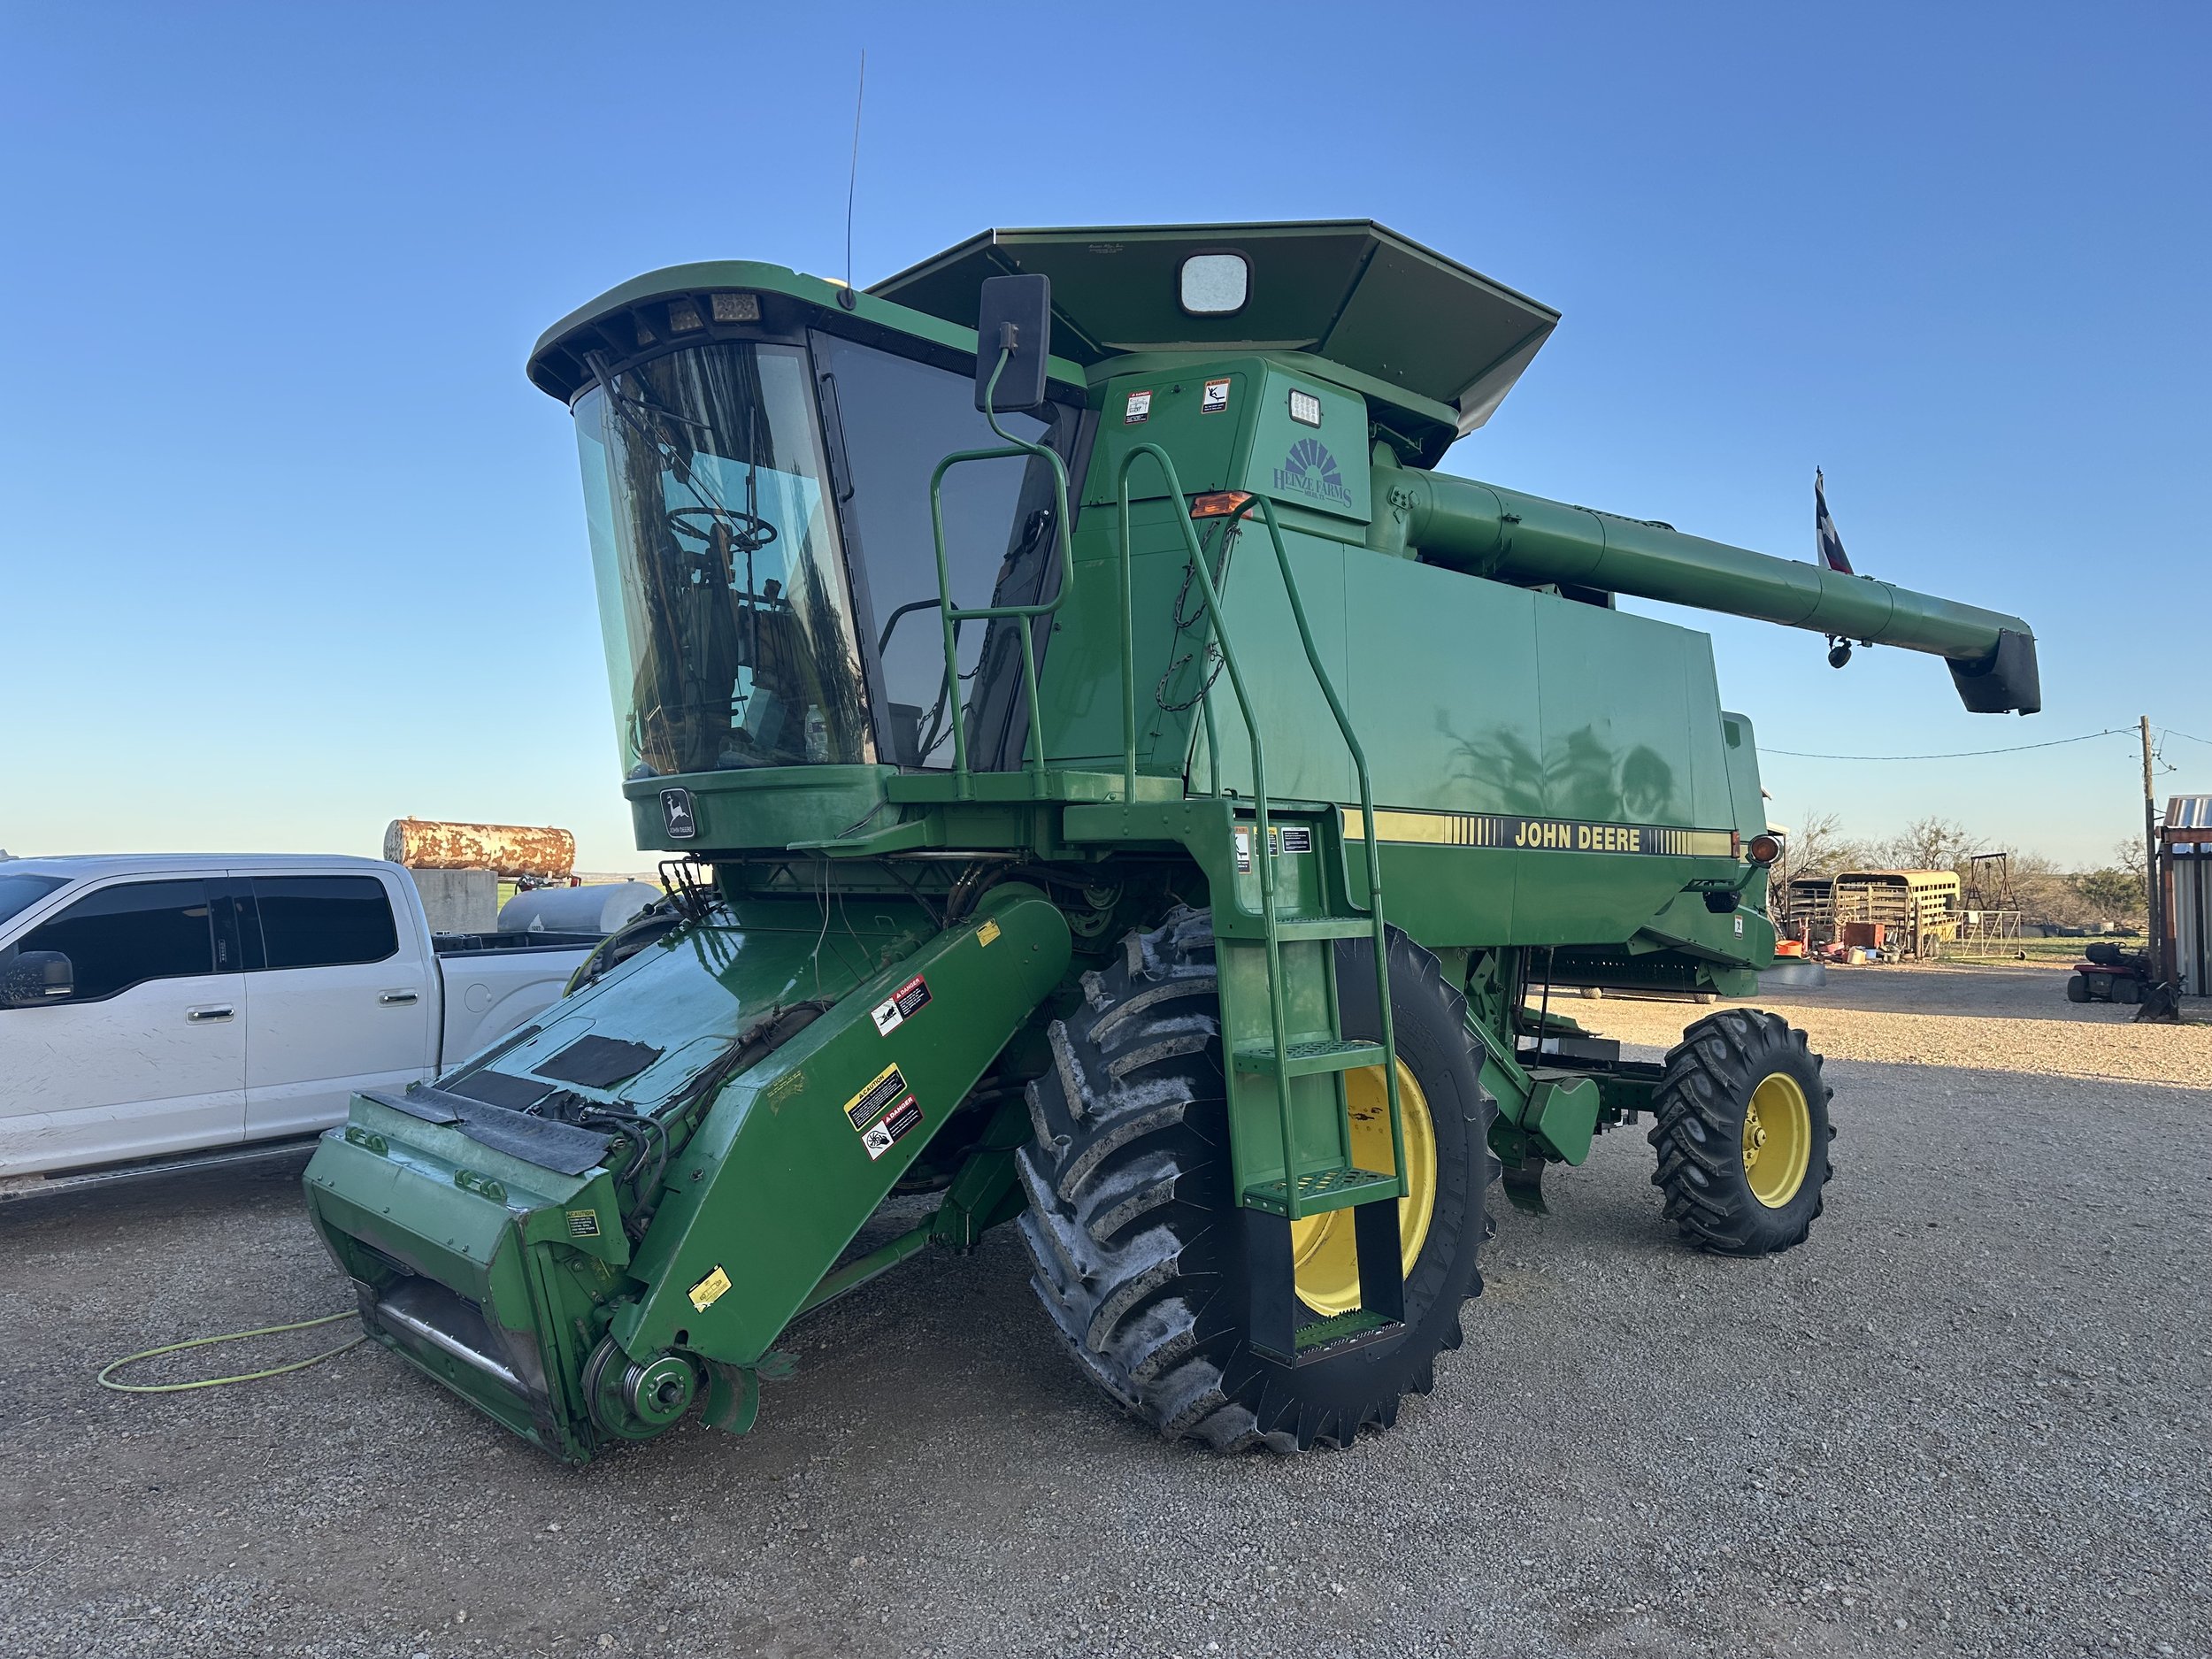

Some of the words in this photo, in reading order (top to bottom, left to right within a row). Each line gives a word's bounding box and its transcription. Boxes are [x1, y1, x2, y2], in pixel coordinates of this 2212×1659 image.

[1273, 468, 1313, 491] HEINZE
[1316, 480, 1352, 509] FARMS
[1515, 821, 1571, 849] JOHN
[1578, 826, 1640, 852] DEERE
[900, 978, 920, 995] DANGER
[863, 1074, 885, 1094] CAUTION
[889, 1096, 913, 1118] DANGER
